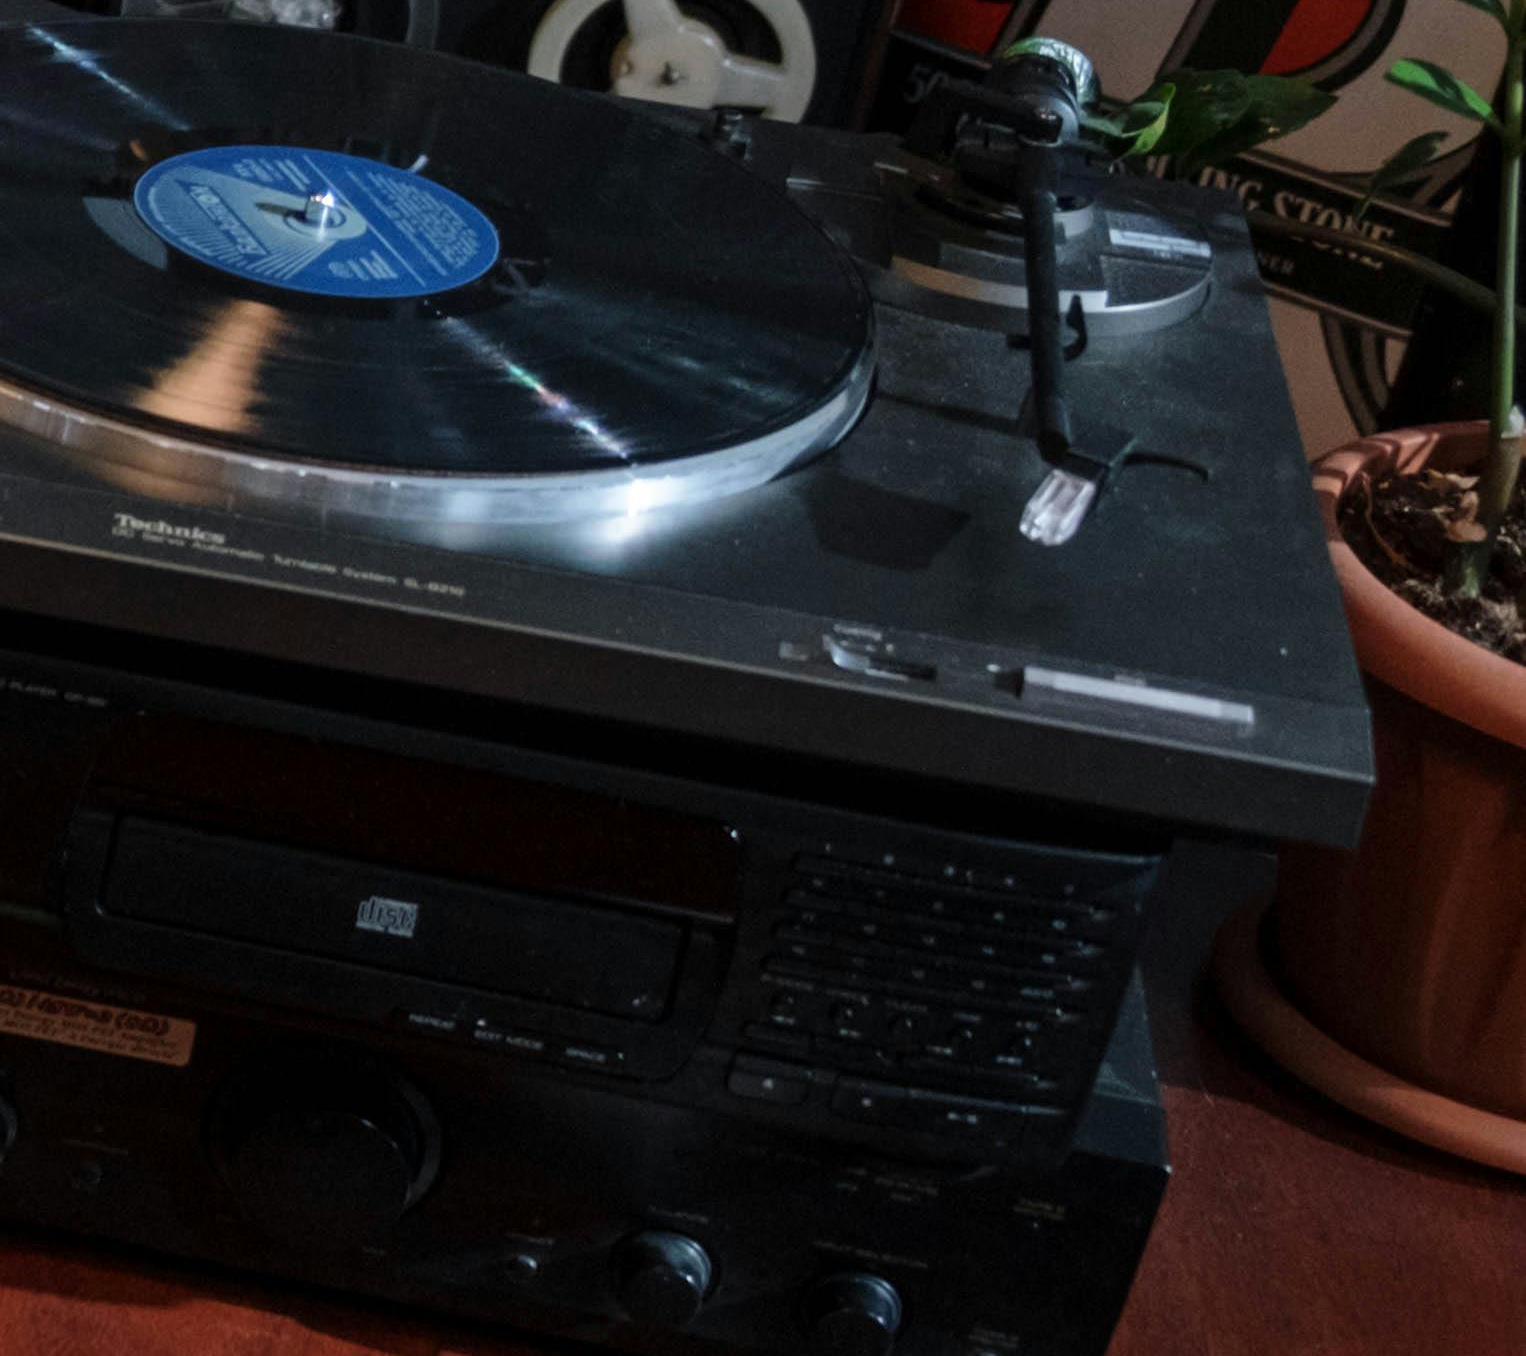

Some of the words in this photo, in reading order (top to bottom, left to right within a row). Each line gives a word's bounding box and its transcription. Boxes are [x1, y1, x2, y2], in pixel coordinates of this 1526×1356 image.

[113, 512, 227, 545] Technics
[191, 540, 266, 562] Automatic
[272, 554, 338, 574] Turntable
